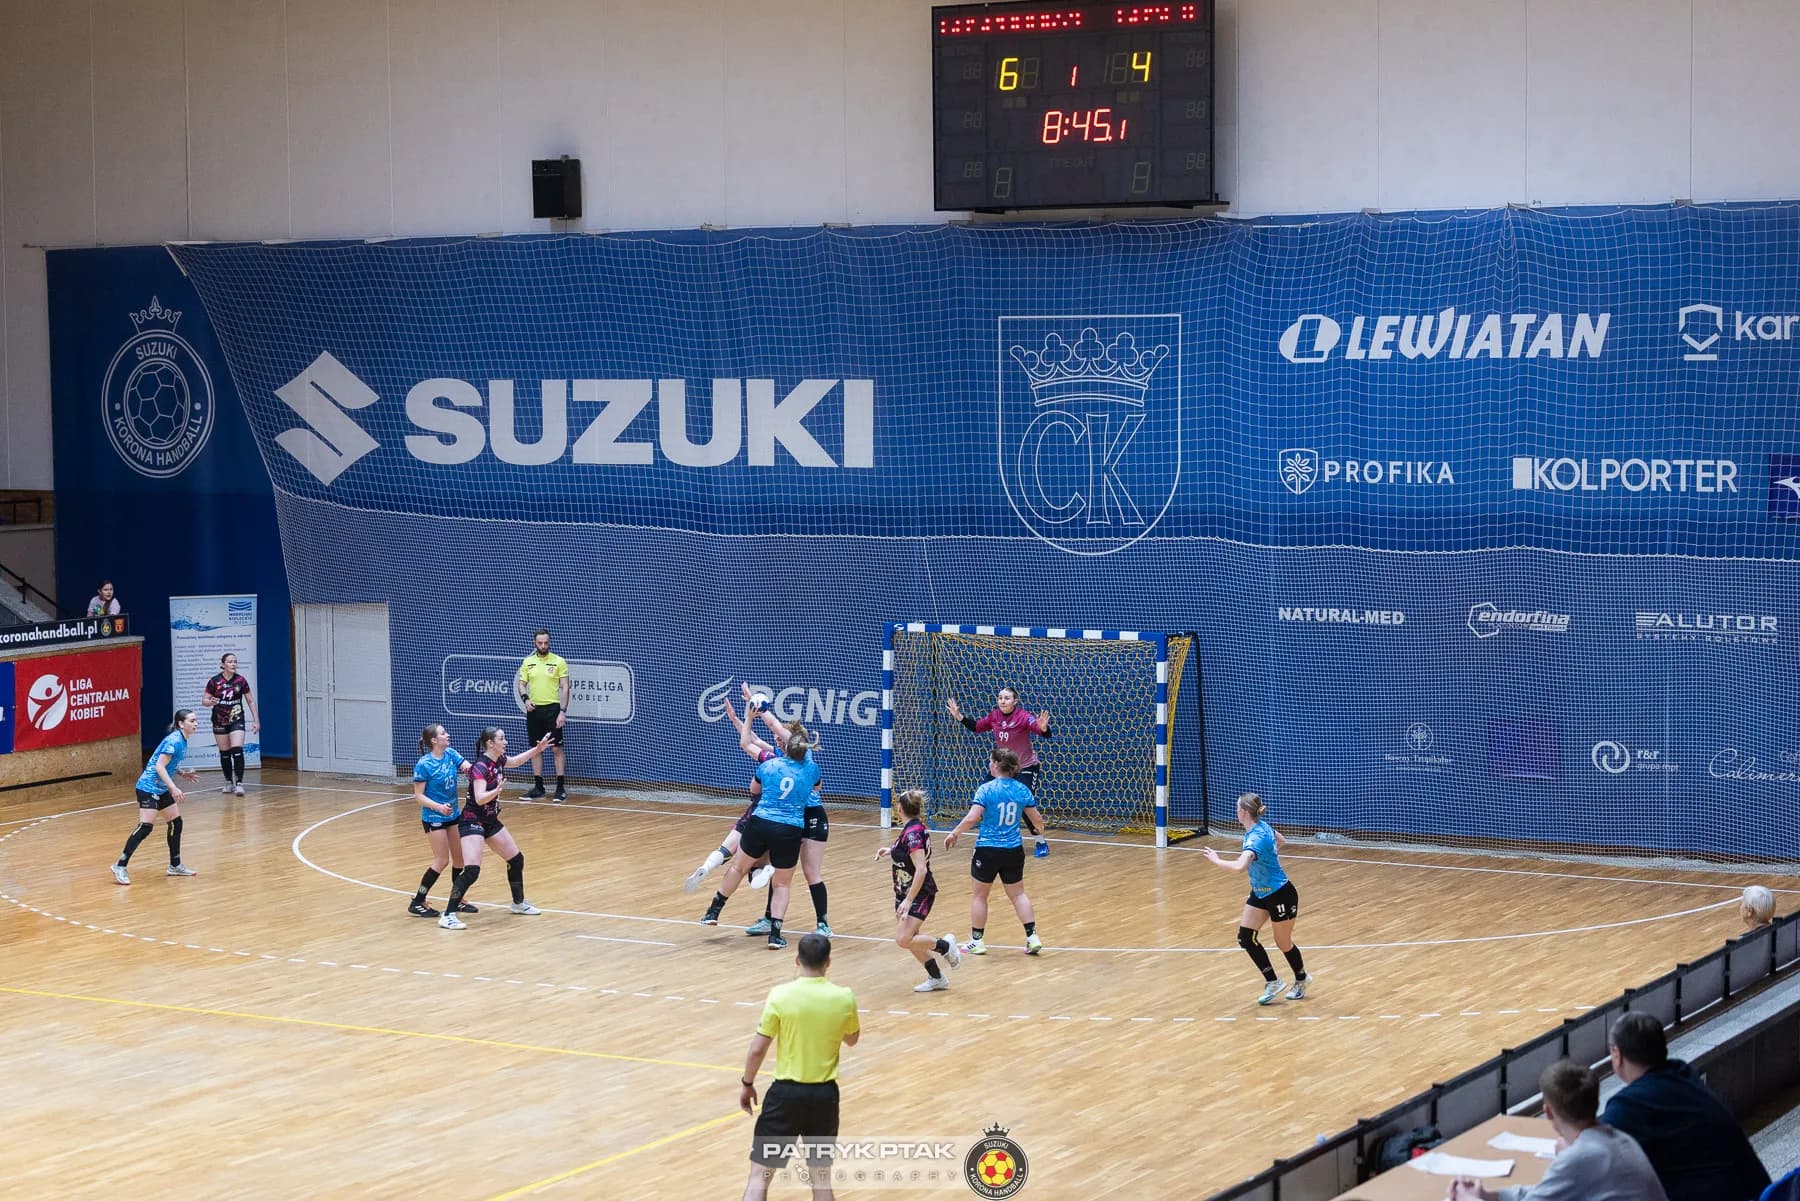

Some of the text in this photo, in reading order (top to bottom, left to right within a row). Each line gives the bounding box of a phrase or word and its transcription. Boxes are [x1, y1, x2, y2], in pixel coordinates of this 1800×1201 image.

[999, 51, 1151, 90] 6 1 4
[1344, 307, 1611, 361] LEWIATAN
[1735, 310, 1800, 341] kar
[135, 341, 178, 360] SUZUKI
[403, 377, 874, 469] SUZUKI
[114, 415, 203, 466] KORONA HANDBALL
[1324, 460, 1455, 485] PROFIKA
[1535, 458, 1738, 493] KOLPORTER
[1278, 607, 1405, 625] NATURAL-MED
[1478, 610, 1570, 625] endorfina
[1655, 613, 1778, 631] ALUTOR
[0, 621, 98, 644] oronahandball.pl
[70, 678, 93, 692] LIGA
[465, 679, 509, 694] PGNiG
[568, 679, 624, 692] PERLIGA
[70, 688, 130, 707] CENTRALNA
[222, 690, 234, 700] 14
[70, 706, 106, 721] KOBIET
[999, 731, 1009, 742] 99
[779, 777, 795, 800] 9
[997, 801, 1018, 827] 18
